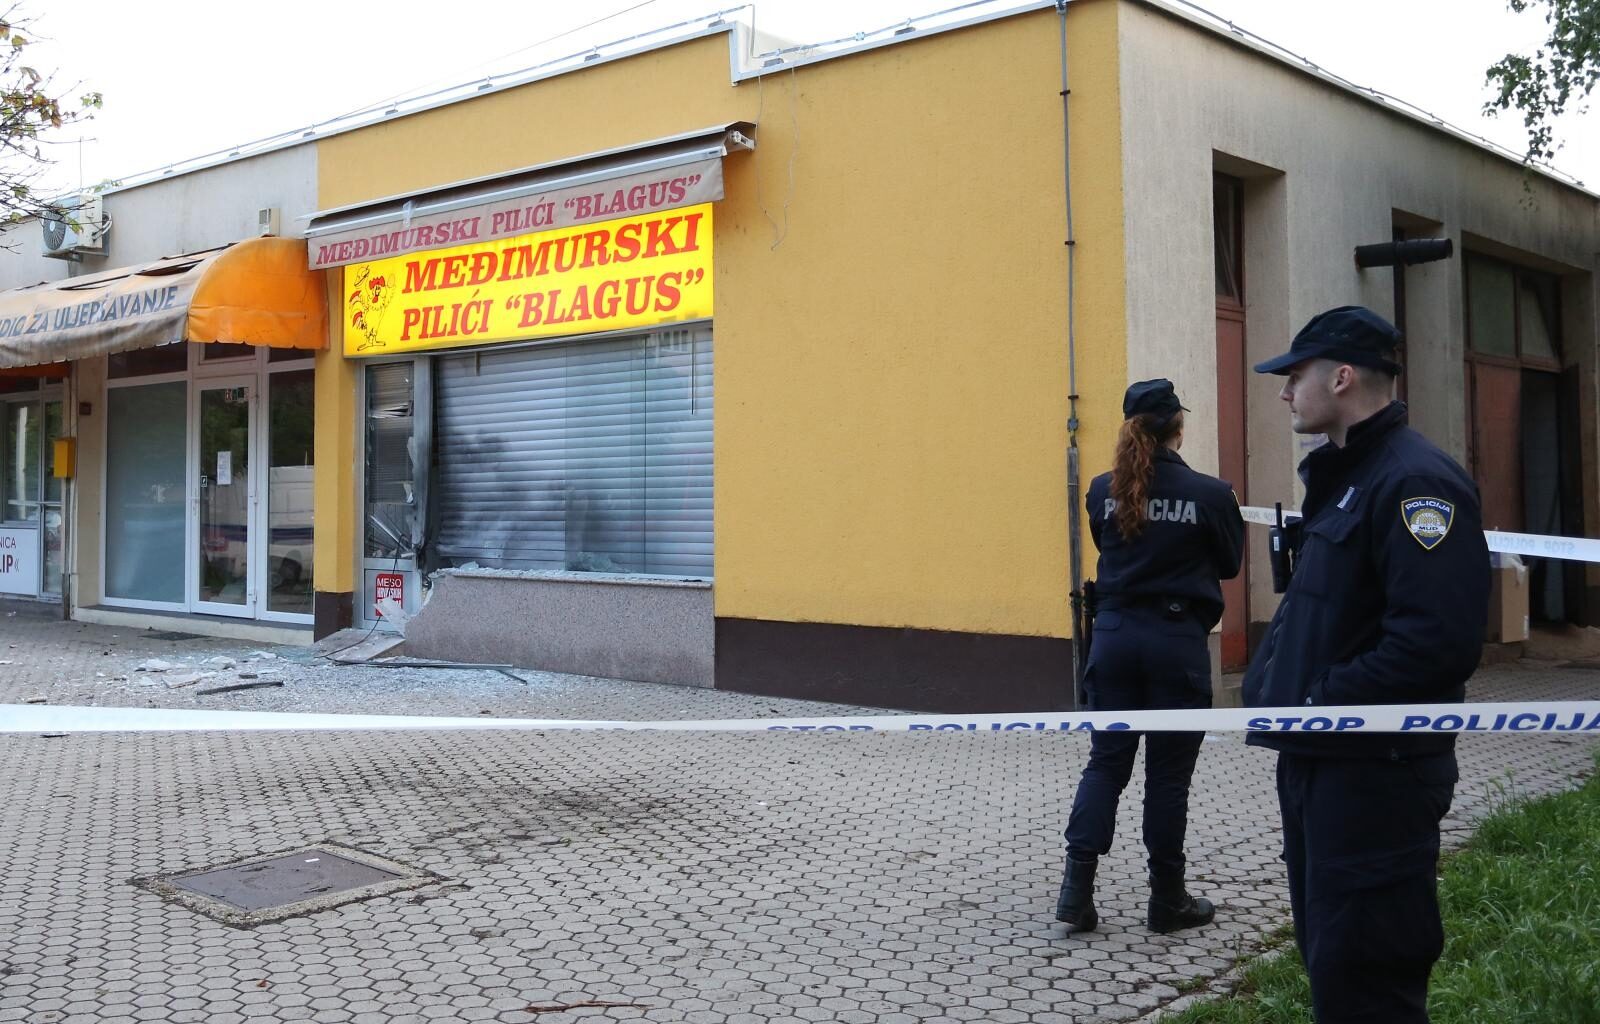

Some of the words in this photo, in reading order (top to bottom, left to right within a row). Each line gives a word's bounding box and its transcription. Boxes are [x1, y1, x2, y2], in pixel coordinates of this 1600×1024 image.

[315, 216, 481, 265] MEĐIMURSKI
[490, 196, 556, 235] PILIĆI
[401, 213, 703, 294] MEĐIMURSKI
[24, 311, 49, 335] ZA
[399, 289, 494, 341] PILIĆI
[1103, 498, 1198, 525] PICIJA
[1405, 500, 1450, 513] POLICIJA
[377, 578, 402, 588] MESO
[1245, 716, 1366, 731] STOP
